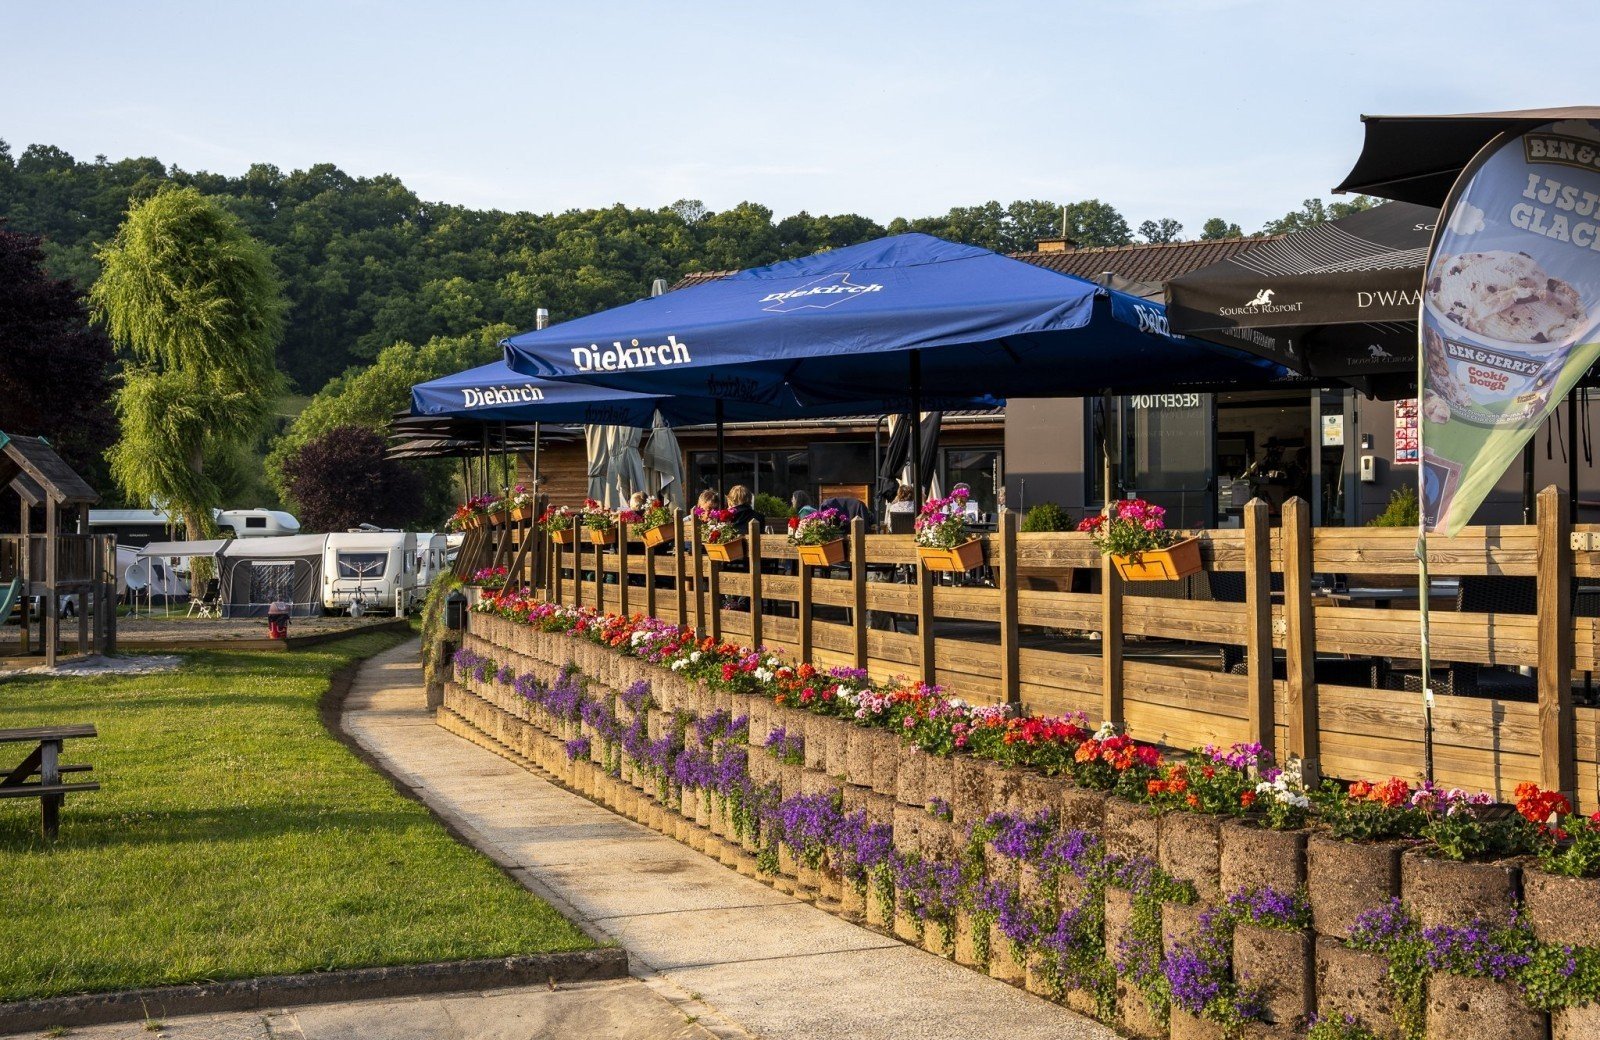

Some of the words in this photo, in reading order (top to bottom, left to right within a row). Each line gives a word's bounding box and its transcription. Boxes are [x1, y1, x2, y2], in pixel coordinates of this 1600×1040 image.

[758, 284, 884, 302] Diekirch
[1219, 303, 1259, 316] SOURCES
[1262, 301, 1303, 314] ROSPORT
[571, 335, 691, 371] Diekirch
[1448, 343, 1475, 360] BEN
[1475, 351, 1488, 363] &
[1486, 354, 1539, 375] JERRY'S
[1468, 366, 1510, 383] Cookie
[1469, 375, 1506, 391] Dough
[461, 384, 545, 408] Diekirch
